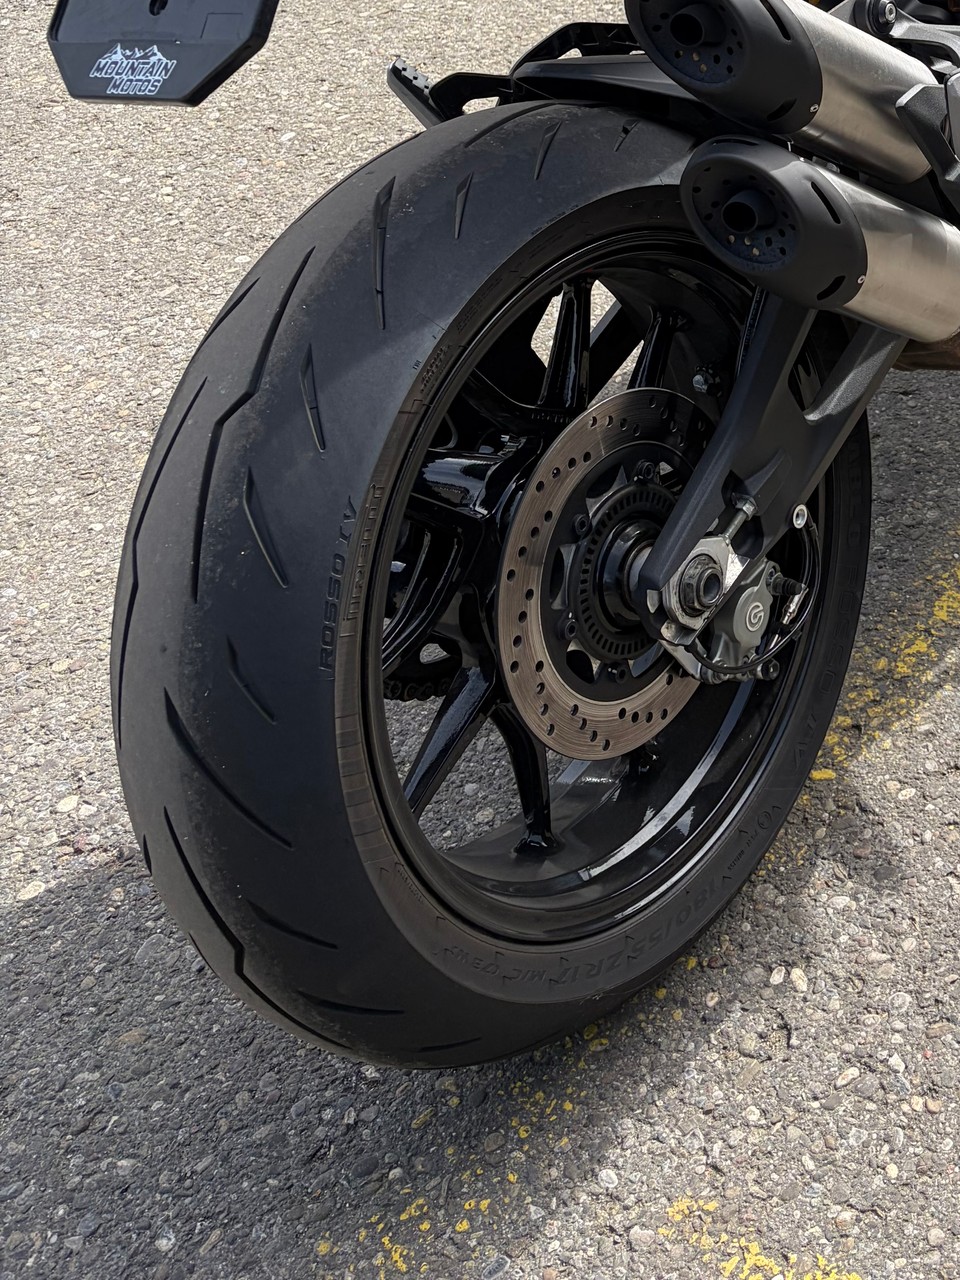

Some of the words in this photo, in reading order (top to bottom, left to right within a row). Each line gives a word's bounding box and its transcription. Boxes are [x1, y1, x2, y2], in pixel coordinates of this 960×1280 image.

[89, 58, 177, 79] MOUNTAIN
[106, 77, 163, 95] MOTOS
[318, 552, 346, 673] ROSSO
